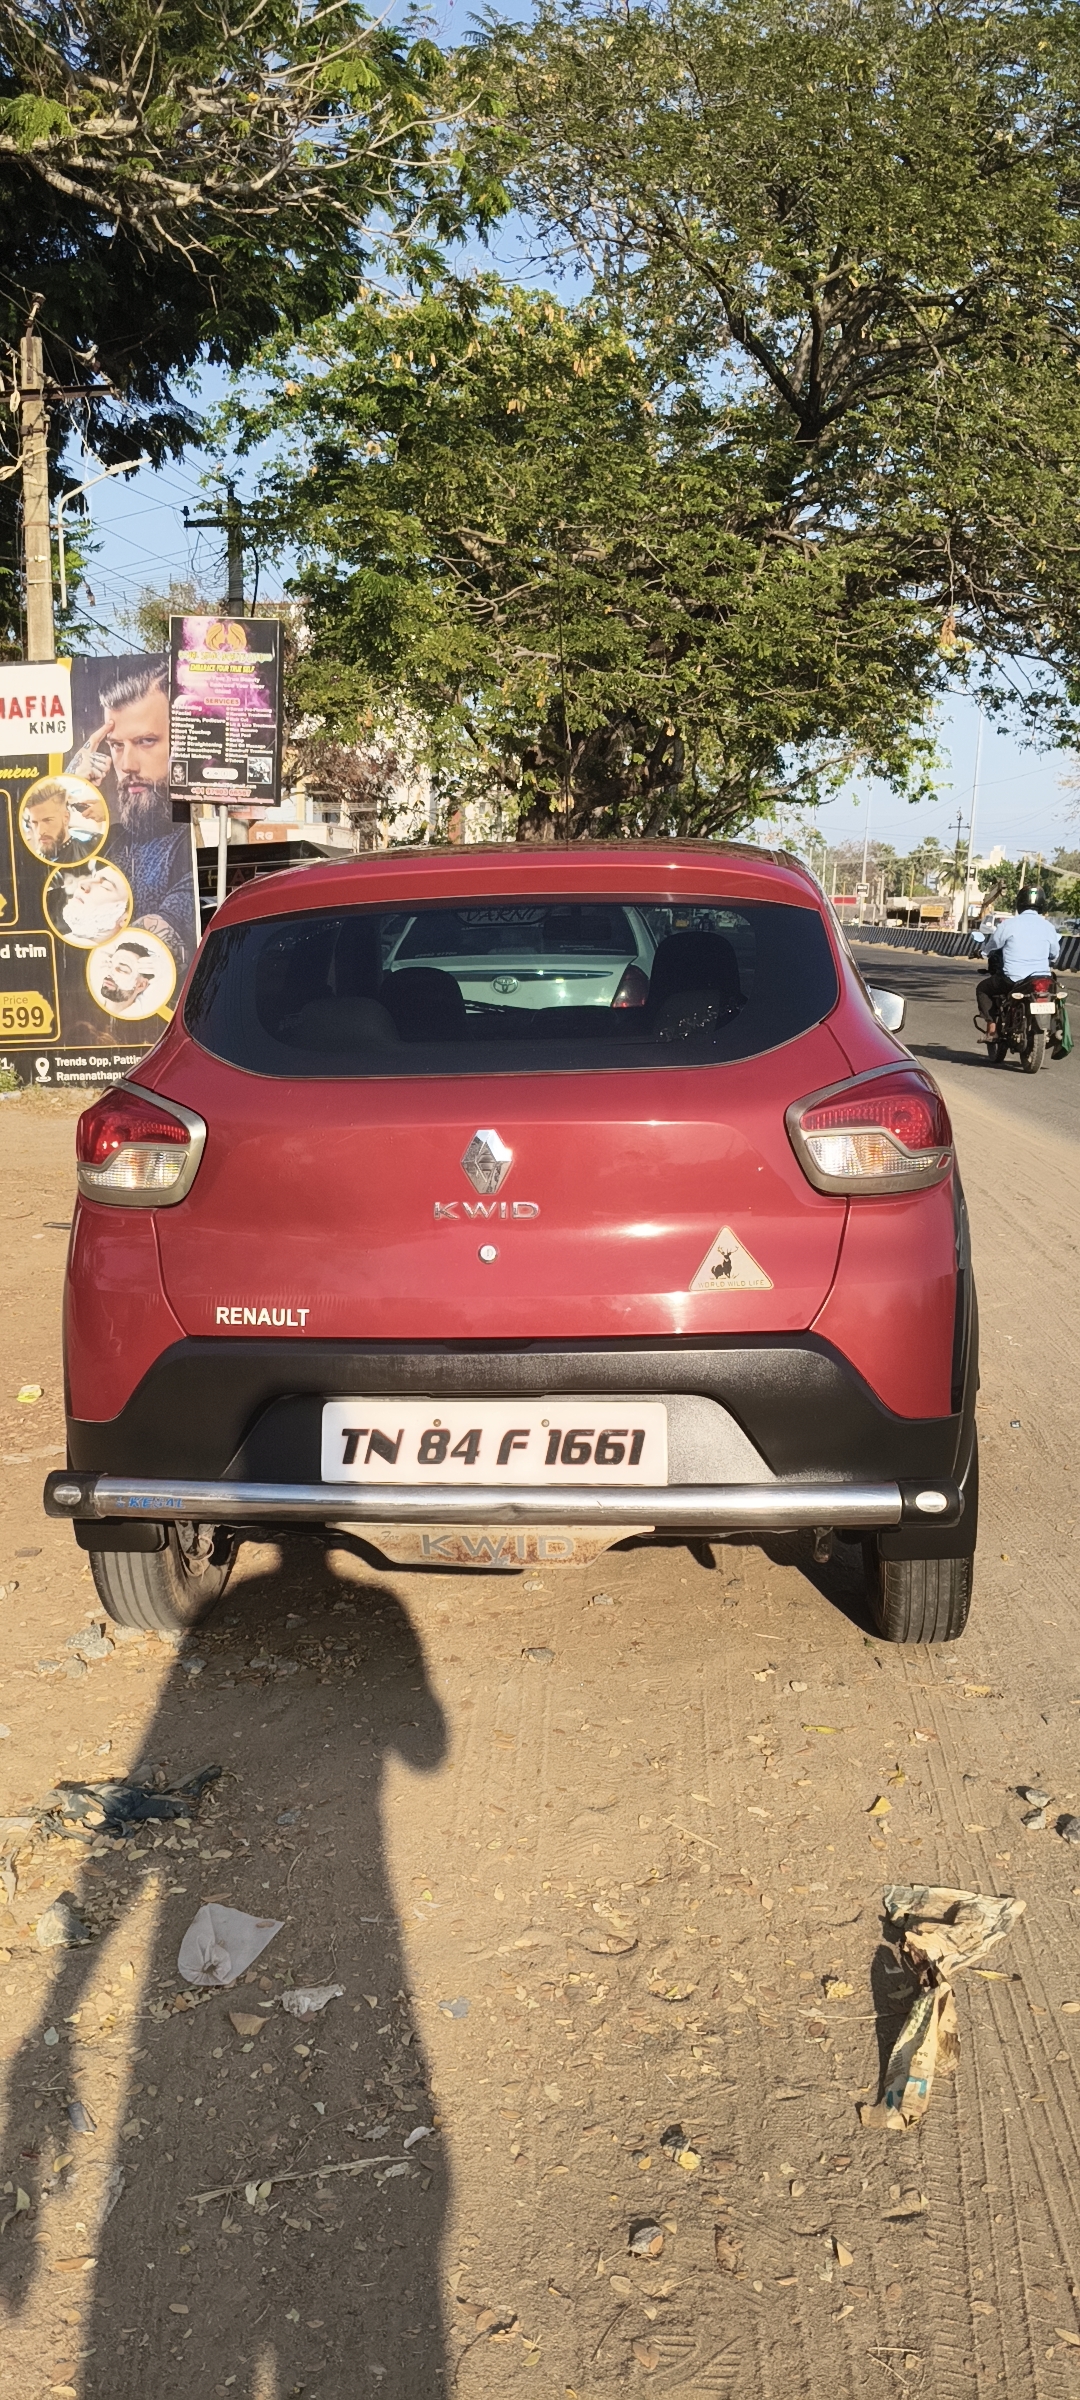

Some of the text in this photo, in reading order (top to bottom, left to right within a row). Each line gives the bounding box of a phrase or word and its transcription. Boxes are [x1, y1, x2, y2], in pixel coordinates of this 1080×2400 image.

[29, 720, 66, 734] KING
[255, 831, 274, 841] RG
[15, 944, 47, 959] trim
[3, 995, 29, 1005] Price
[2, 1006, 45, 1029] 599
[55, 1057, 87, 1067] Trends
[89, 1056, 111, 1067] Opp,
[433, 1201, 540, 1220] KWID
[698, 1281, 725, 1289] WORLD
[215, 1306, 310, 1327] RENAULT
[341, 1428, 646, 1466] TN 84 F 1661
[380, 1530, 400, 1543] For
[420, 1533, 577, 1561] KWID
